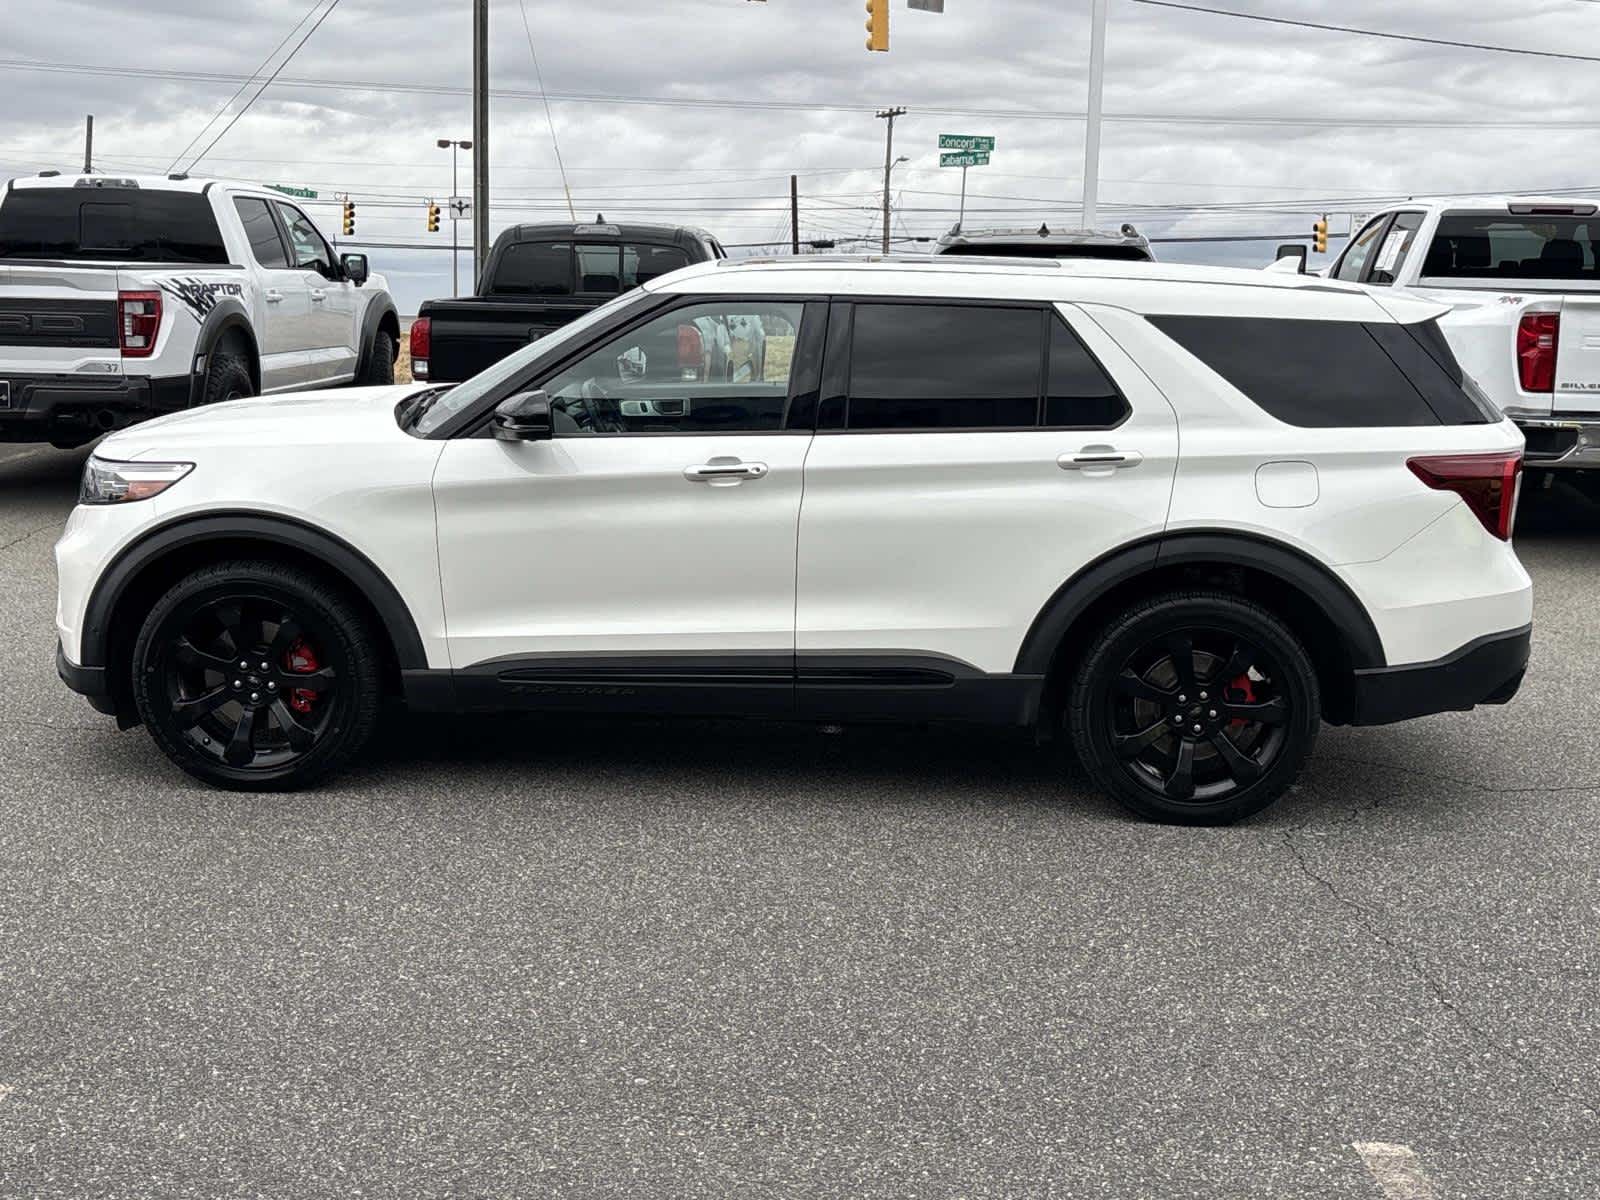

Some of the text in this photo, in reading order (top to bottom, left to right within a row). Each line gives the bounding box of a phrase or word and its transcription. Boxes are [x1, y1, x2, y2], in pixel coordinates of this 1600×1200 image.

[940, 136, 975, 149] Concord
[189, 284, 241, 296] RAPTOR
[104, 363, 118, 373] 37
